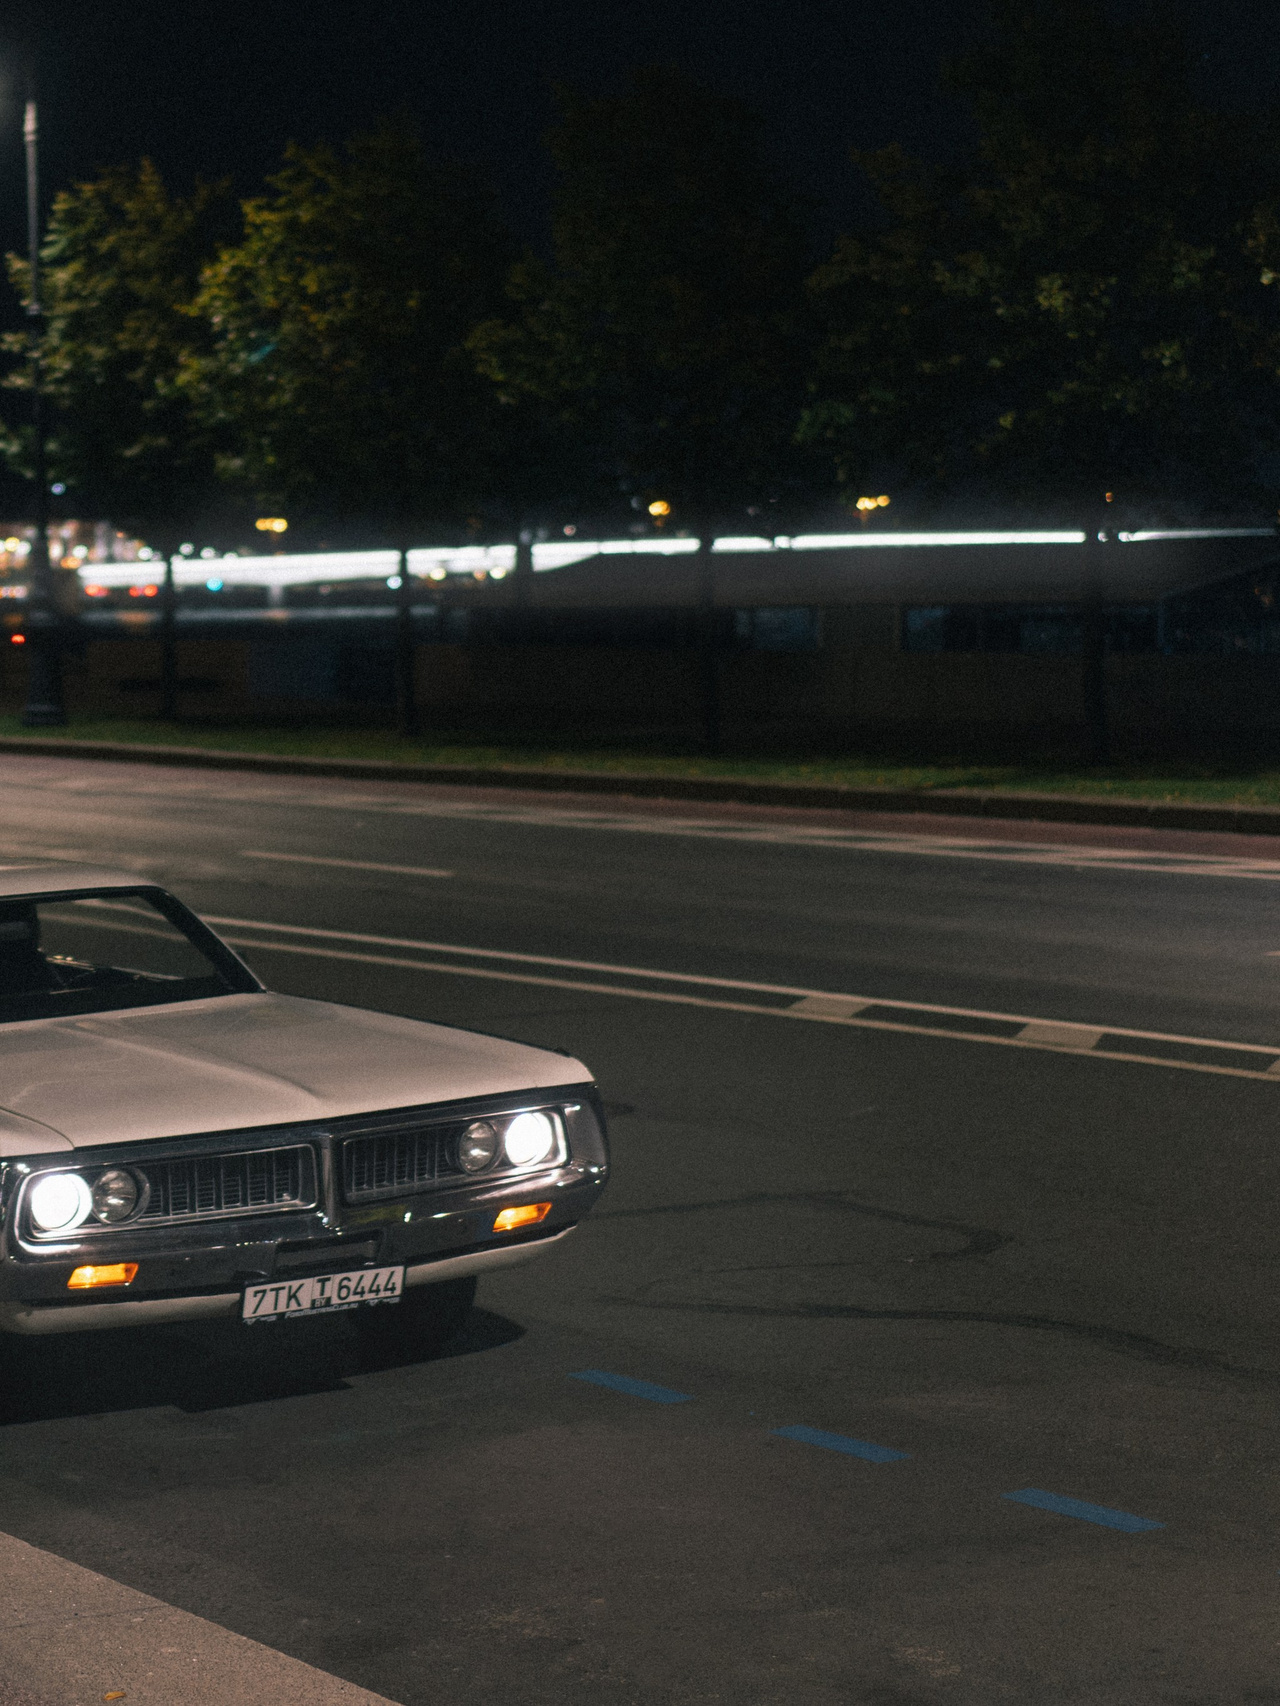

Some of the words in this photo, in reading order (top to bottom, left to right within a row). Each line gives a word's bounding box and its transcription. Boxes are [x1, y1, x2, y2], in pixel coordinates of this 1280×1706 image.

[252, 1283, 305, 1314] 7TK
[337, 1271, 396, 1301] 6444
[314, 1297, 327, 1308] BY
